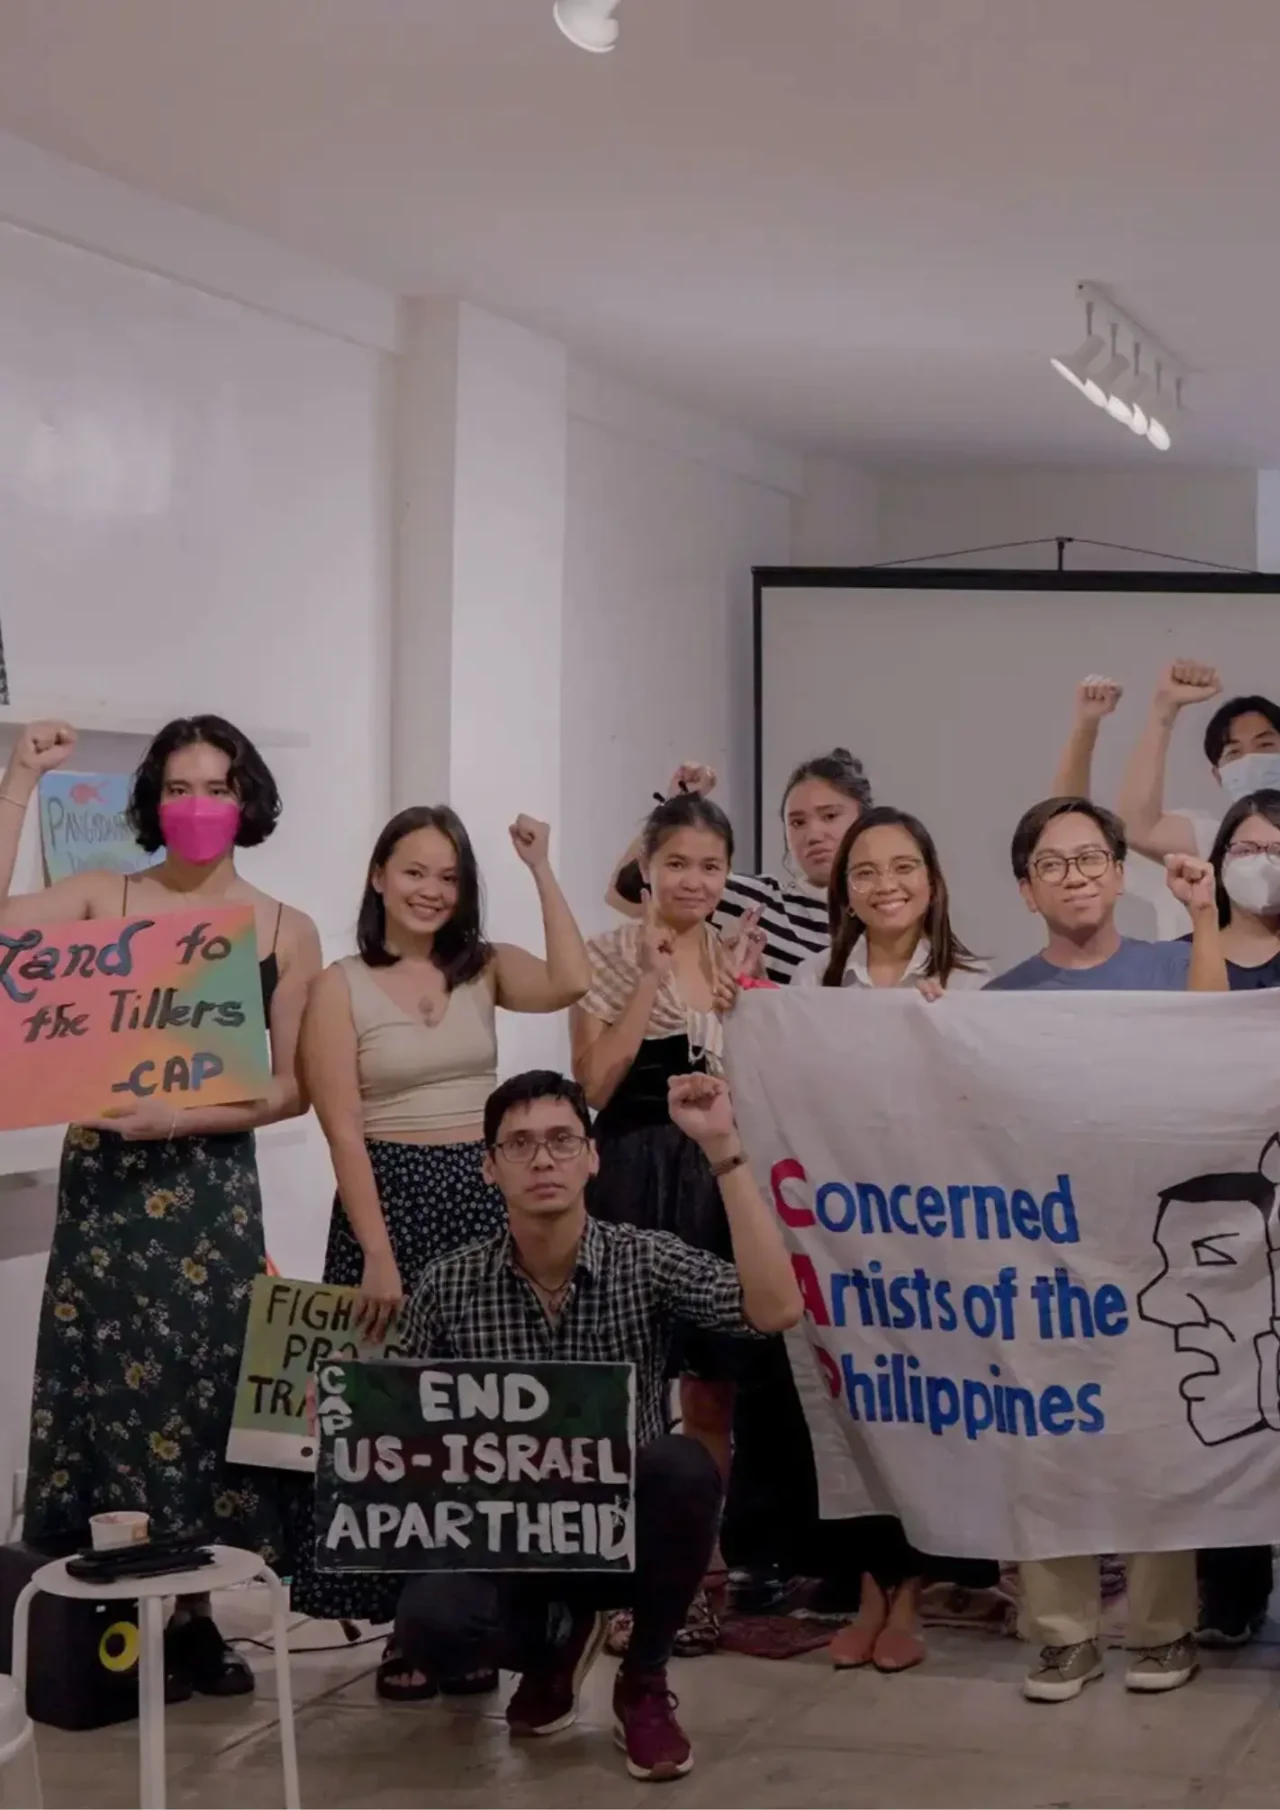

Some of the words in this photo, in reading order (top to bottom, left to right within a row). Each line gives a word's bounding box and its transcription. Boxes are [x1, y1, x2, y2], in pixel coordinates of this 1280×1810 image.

[0, 919, 156, 1004] Land
[175, 922, 232, 965] to
[22, 1002, 91, 1043] the
[109, 986, 247, 1033] Tillers
[770, 1158, 1081, 1244] Concerned
[266, 1284, 355, 1333] FIGH
[790, 1253, 959, 1331] Artists
[964, 1266, 1018, 1341] of
[1030, 1267, 1130, 1339] the
[418, 1369, 550, 1423] END
[333, 1433, 628, 1485] US-ISRAEL
[325, 1497, 631, 1561] APARTHEID
